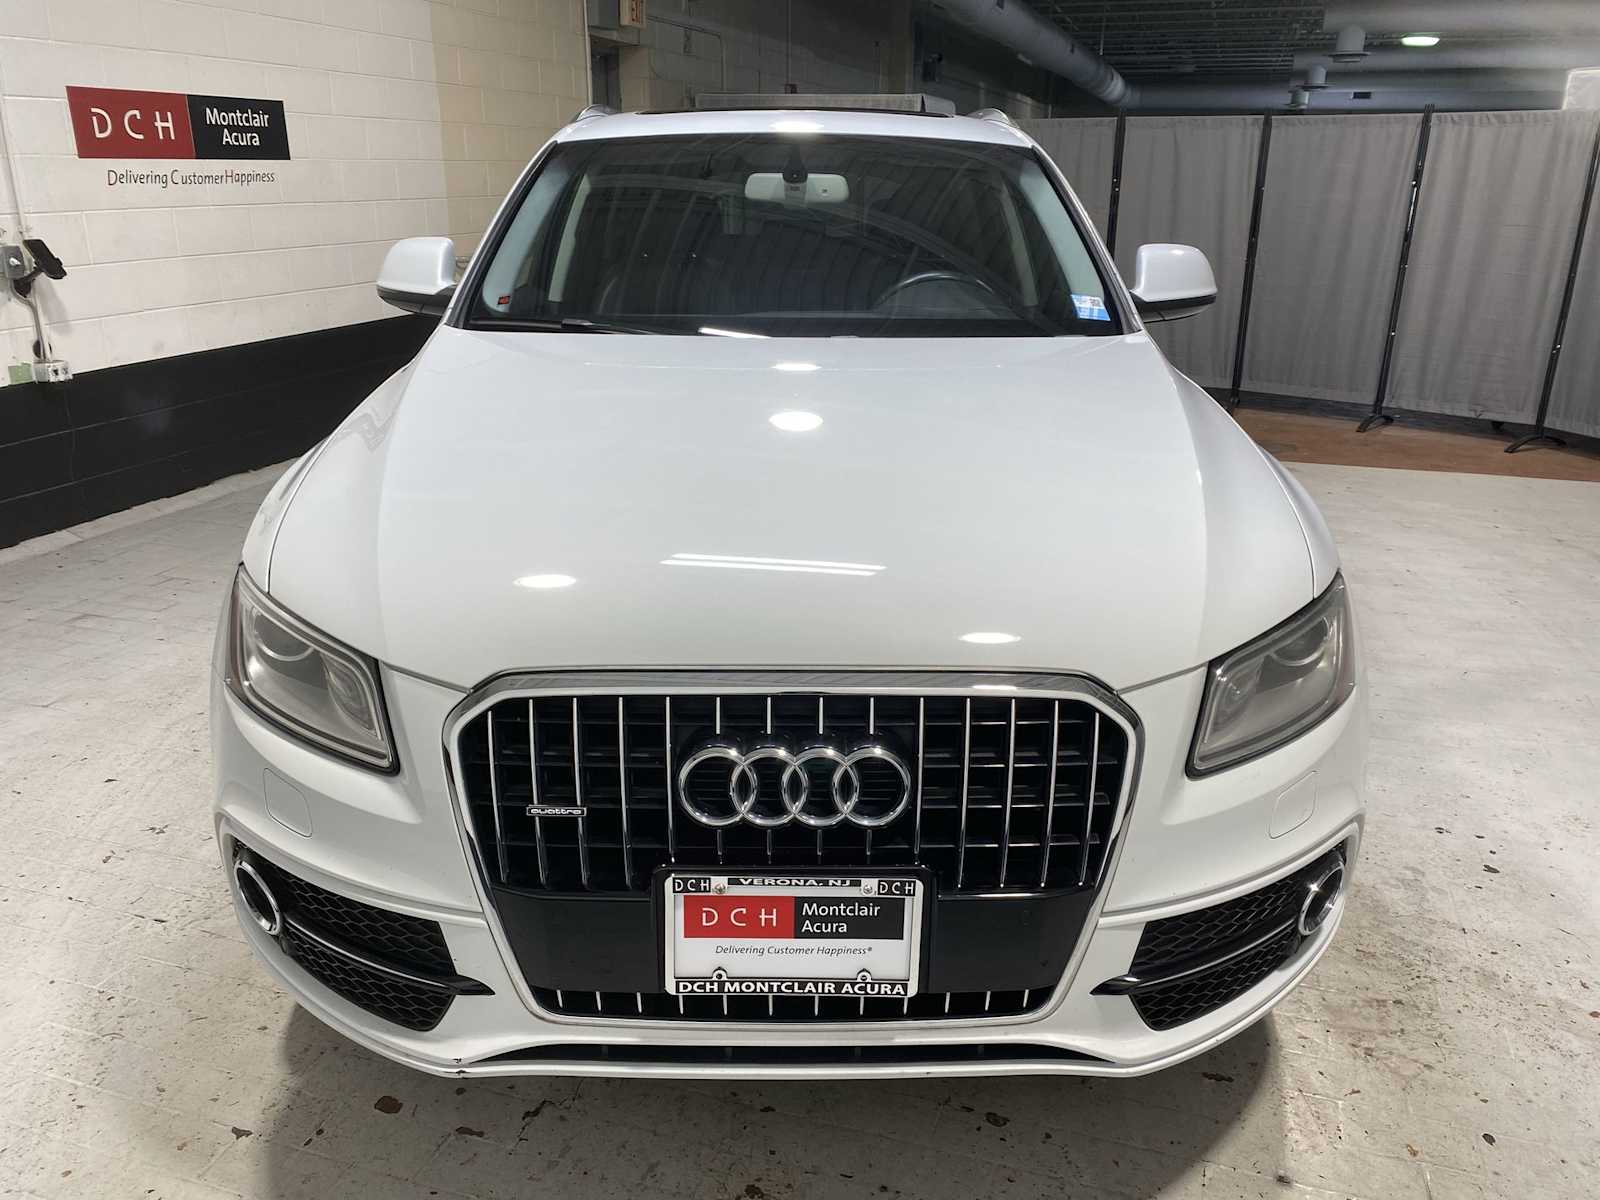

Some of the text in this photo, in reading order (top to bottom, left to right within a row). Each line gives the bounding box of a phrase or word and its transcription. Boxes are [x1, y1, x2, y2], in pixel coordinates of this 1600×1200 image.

[206, 107, 269, 127] Montclair
[222, 128, 260, 146] Acura
[107, 169, 168, 188] Delivering
[828, 879, 850, 887] NJ
[802, 903, 880, 917] Montclair
[801, 919, 847, 933] Acura
[715, 945, 765, 957] Delivering
[767, 946, 815, 955] Customer
[678, 981, 905, 995] DCH MONTCLAIR ACURA
